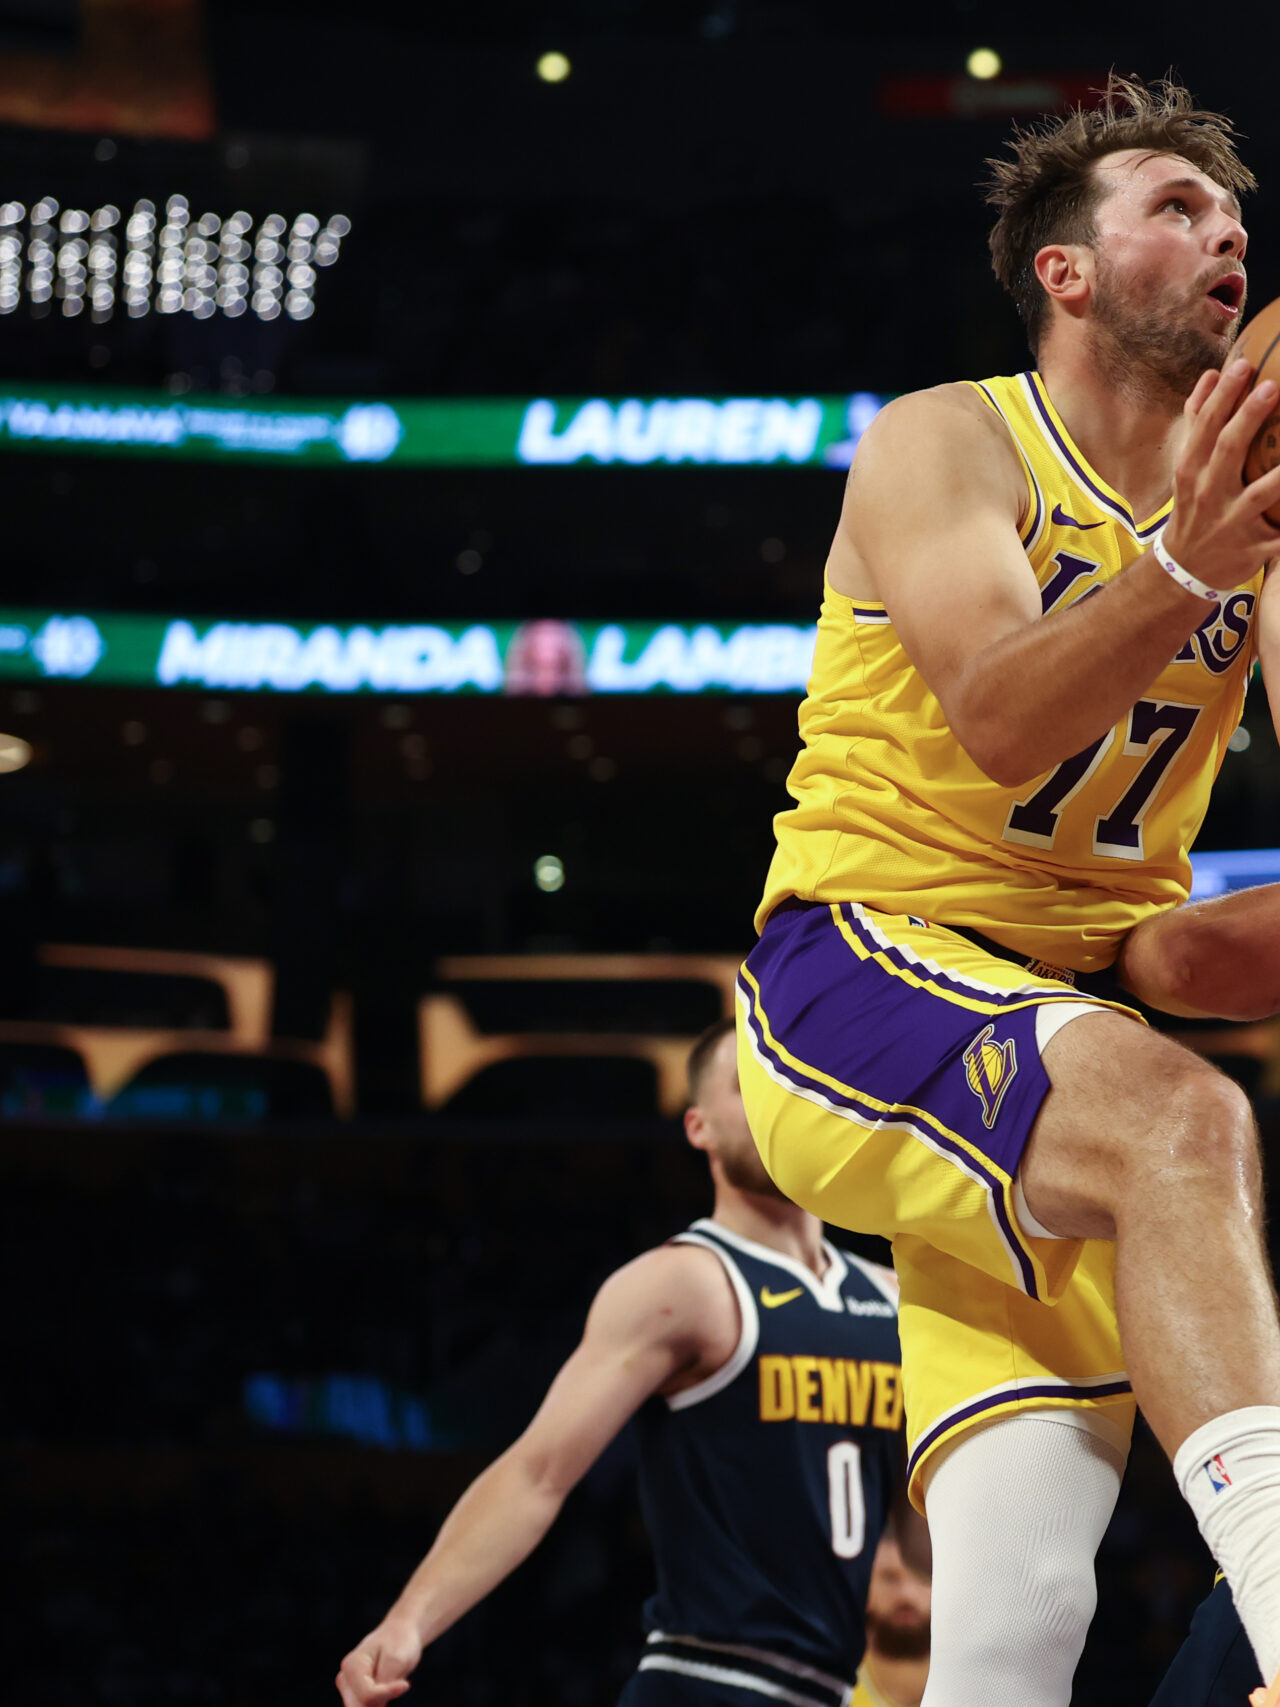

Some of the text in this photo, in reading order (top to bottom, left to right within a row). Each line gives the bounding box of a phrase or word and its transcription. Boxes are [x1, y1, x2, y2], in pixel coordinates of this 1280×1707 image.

[516, 397, 824, 466] LAUREN
[156, 618, 502, 692] MIRANDA
[757, 1353, 904, 1432] DENVE
[826, 1439, 867, 1560] 0
